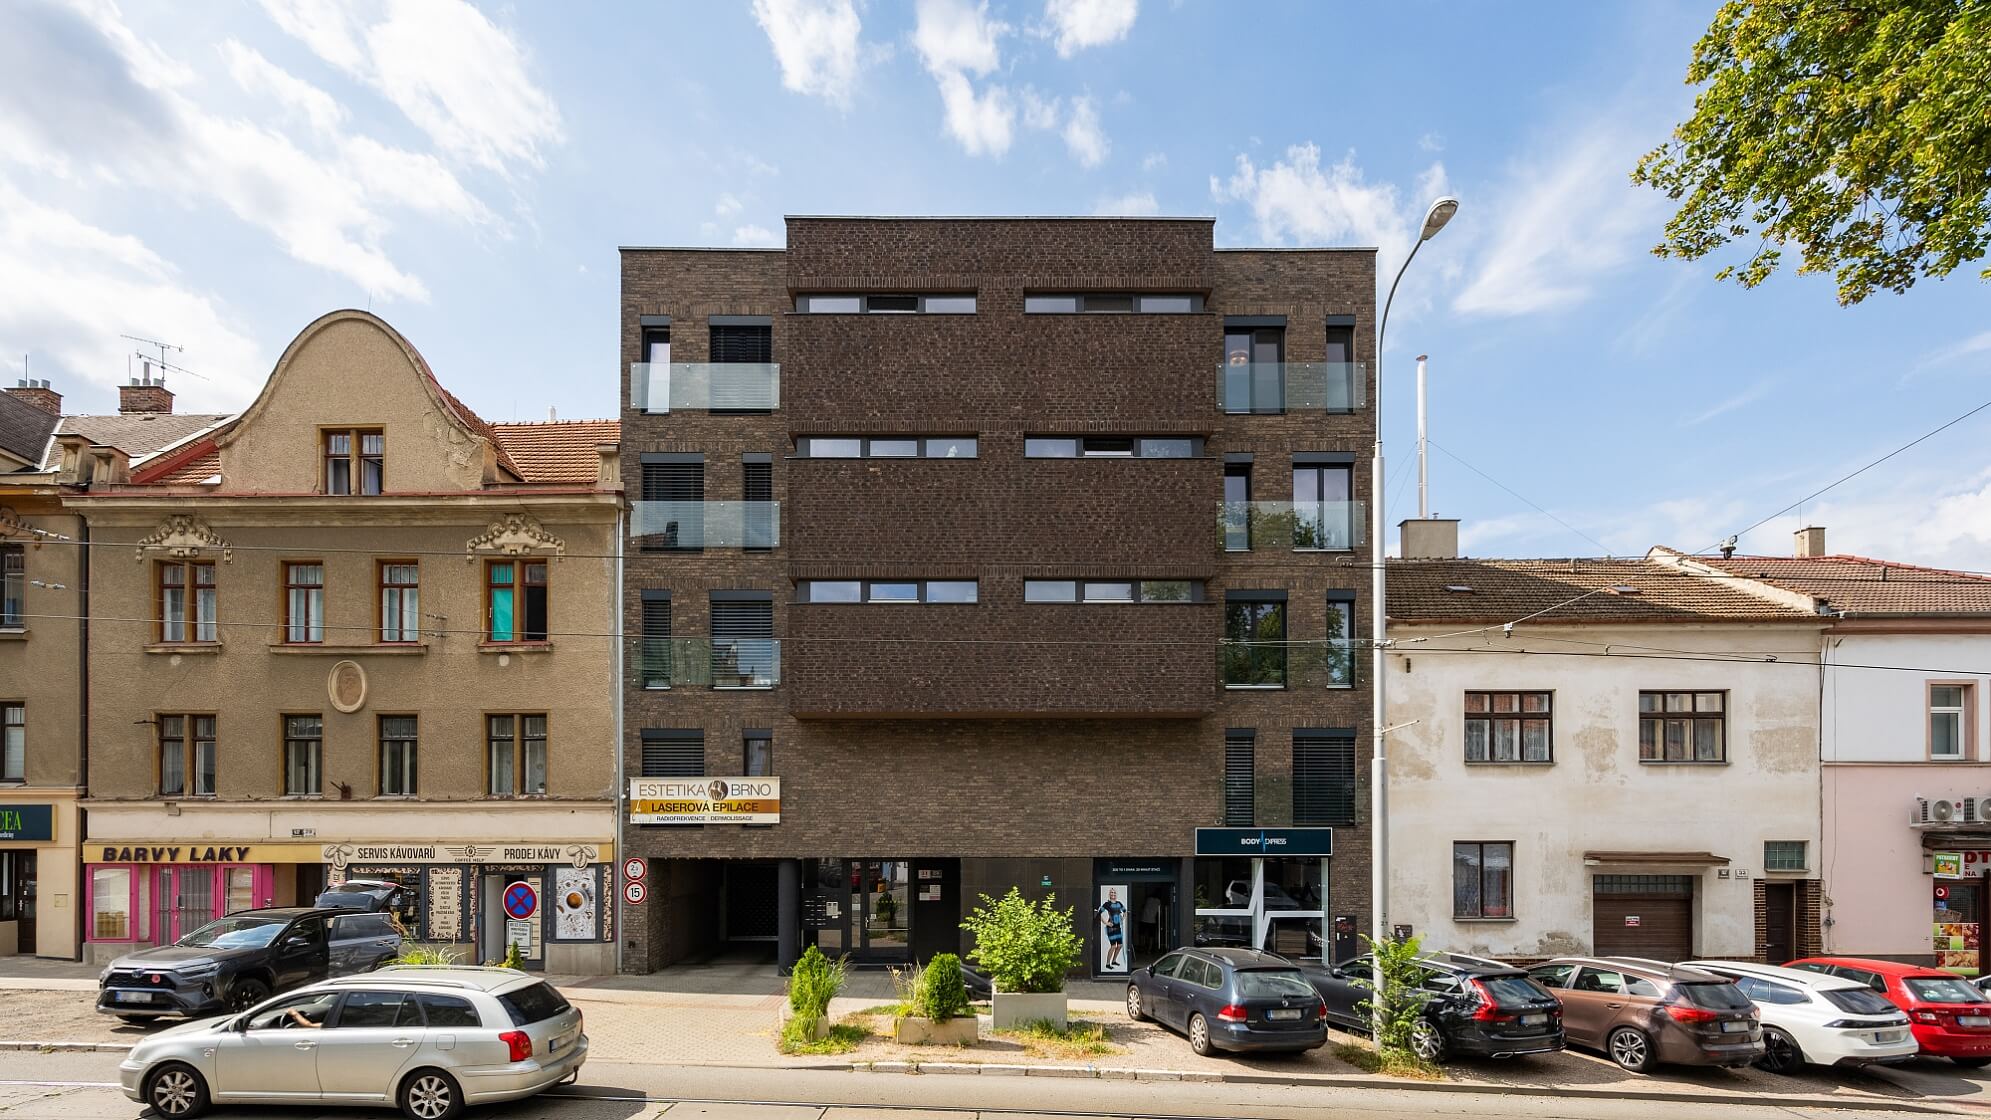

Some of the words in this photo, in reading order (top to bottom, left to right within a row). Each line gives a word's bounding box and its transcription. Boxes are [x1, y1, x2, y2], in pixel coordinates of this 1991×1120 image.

[639, 784, 706, 797] ESTETIKA
[731, 784, 772, 797] BRNO
[651, 800, 711, 812] LASEROVÁ
[712, 802, 759, 812] EPILACE
[102, 847, 180, 862] BARVY
[189, 847, 250, 862] LAKY
[357, 847, 388, 859] SERVIS
[389, 844, 436, 859] KÁVOVARŮ
[504, 848, 536, 860] PRODEJ
[537, 846, 561, 860] KÁVY
[630, 887, 640, 898] 15
